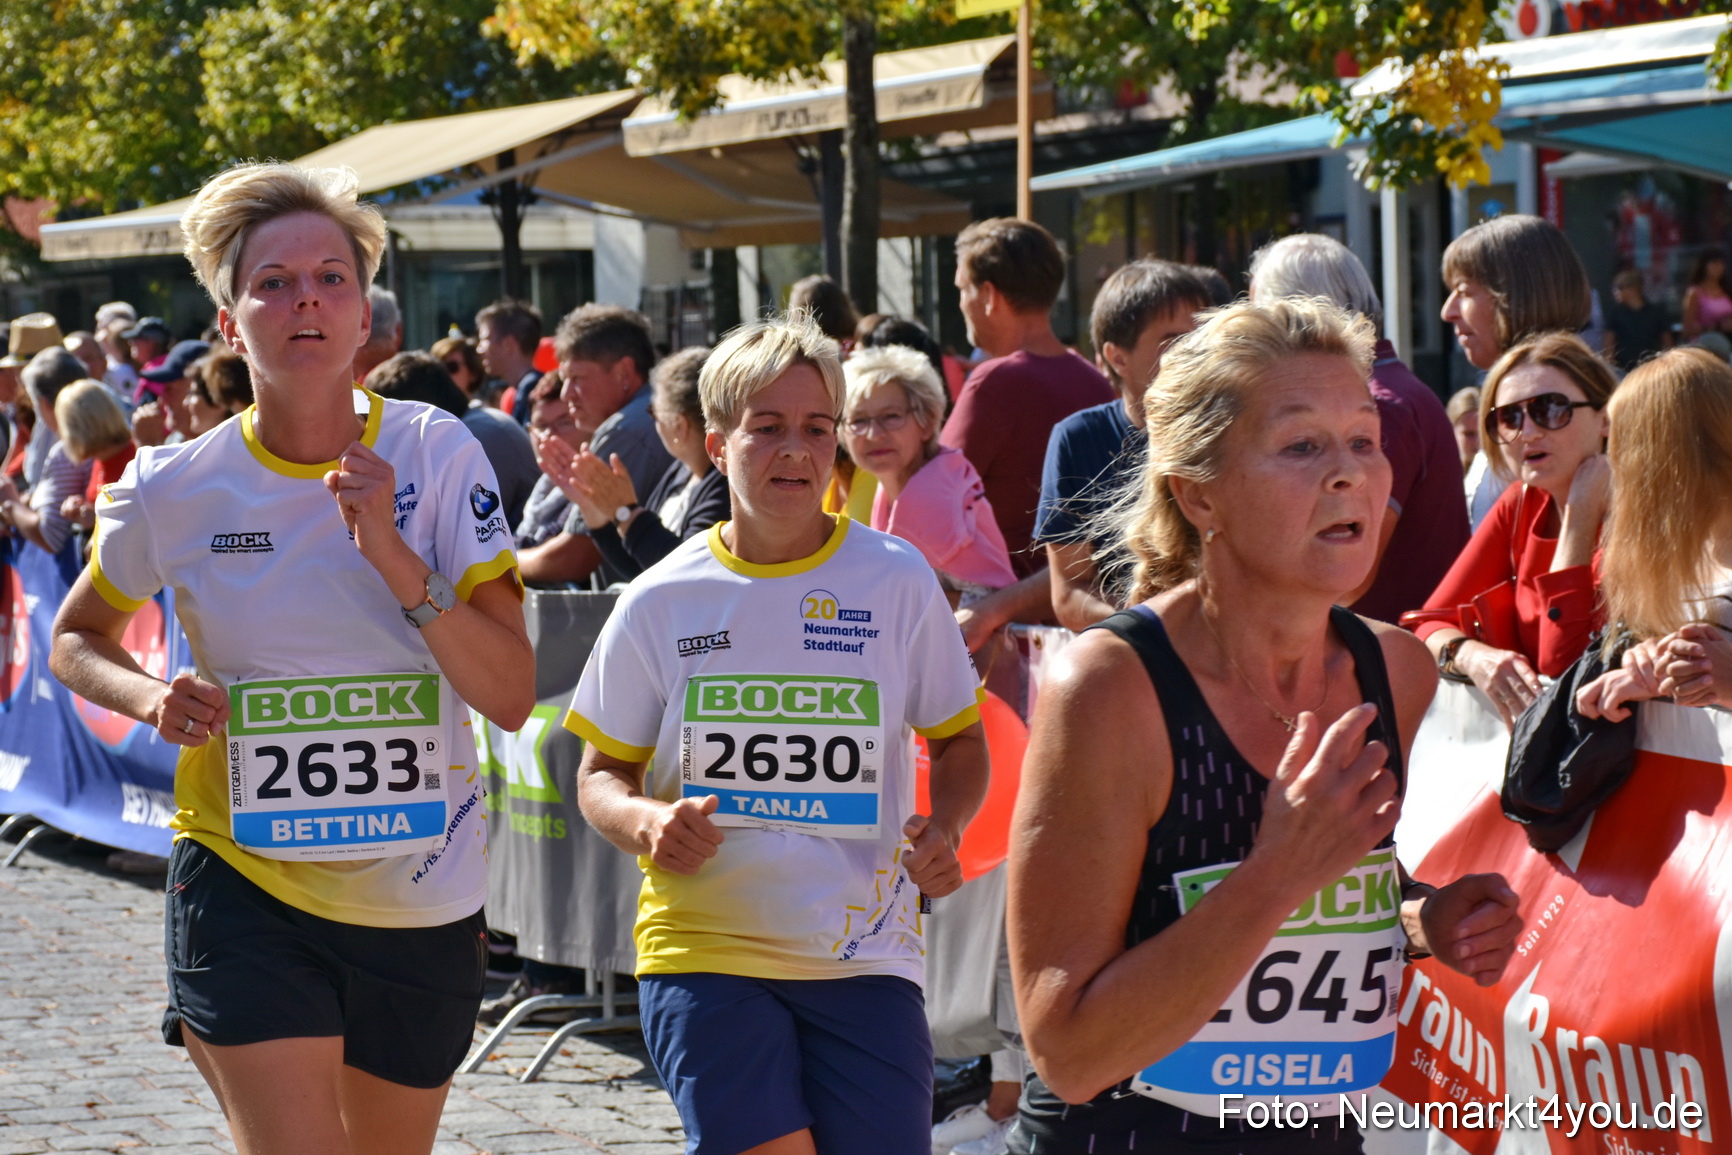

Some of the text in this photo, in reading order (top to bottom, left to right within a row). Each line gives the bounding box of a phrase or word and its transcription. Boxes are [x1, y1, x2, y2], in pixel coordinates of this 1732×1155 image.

[211, 532, 273, 548] BOCK
[804, 597, 869, 620] 20 JAHRE
[804, 623, 880, 638] Neumarkter
[804, 639, 865, 656] Stadtlauf
[244, 682, 422, 726] BOCK
[700, 683, 865, 717] BOCK
[426, 742, 435, 751] D
[705, 732, 860, 783] 2630
[866, 741, 874, 750] D
[255, 738, 420, 799] 2633
[732, 796, 828, 818] TANJA
[272, 812, 412, 842] BETTINA
[411, 853, 441, 884] 14./15.
[1517, 894, 1565, 956] Seit 1929
[1208, 946, 1392, 1024] 645
[1397, 968, 1497, 1097] raun
[1504, 960, 1712, 1144] Braun
[1211, 1054, 1354, 1086] GISELA
[1411, 1048, 1450, 1088] Sicher
[1450, 1078, 1468, 1102] ist
